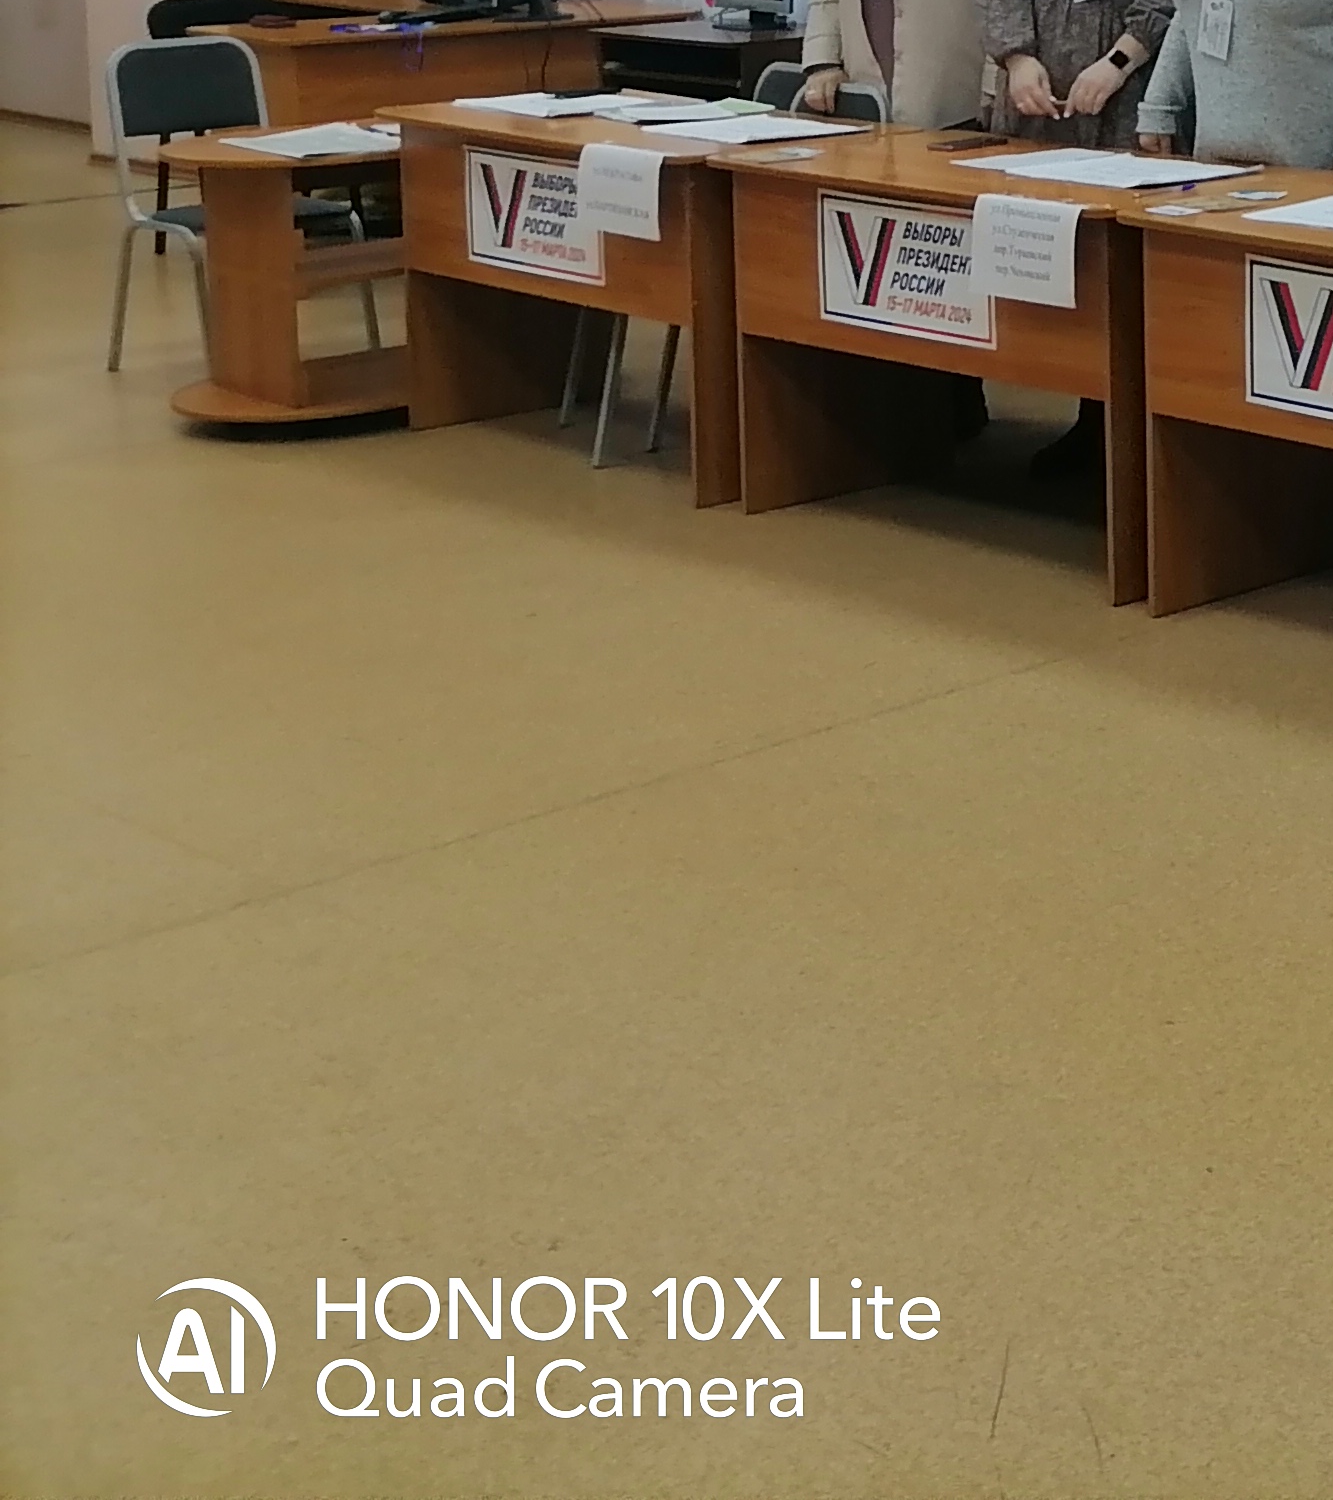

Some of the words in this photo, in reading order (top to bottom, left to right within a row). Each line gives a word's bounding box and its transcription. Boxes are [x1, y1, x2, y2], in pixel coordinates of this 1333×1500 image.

[526, 194, 578, 218] ПРЕЗИДЕ
[902, 221, 965, 248] ВЫБОРЫ
[896, 247, 973, 276] ПРЕЗИДЕНТ
[889, 271, 946, 297] РОССИИ
